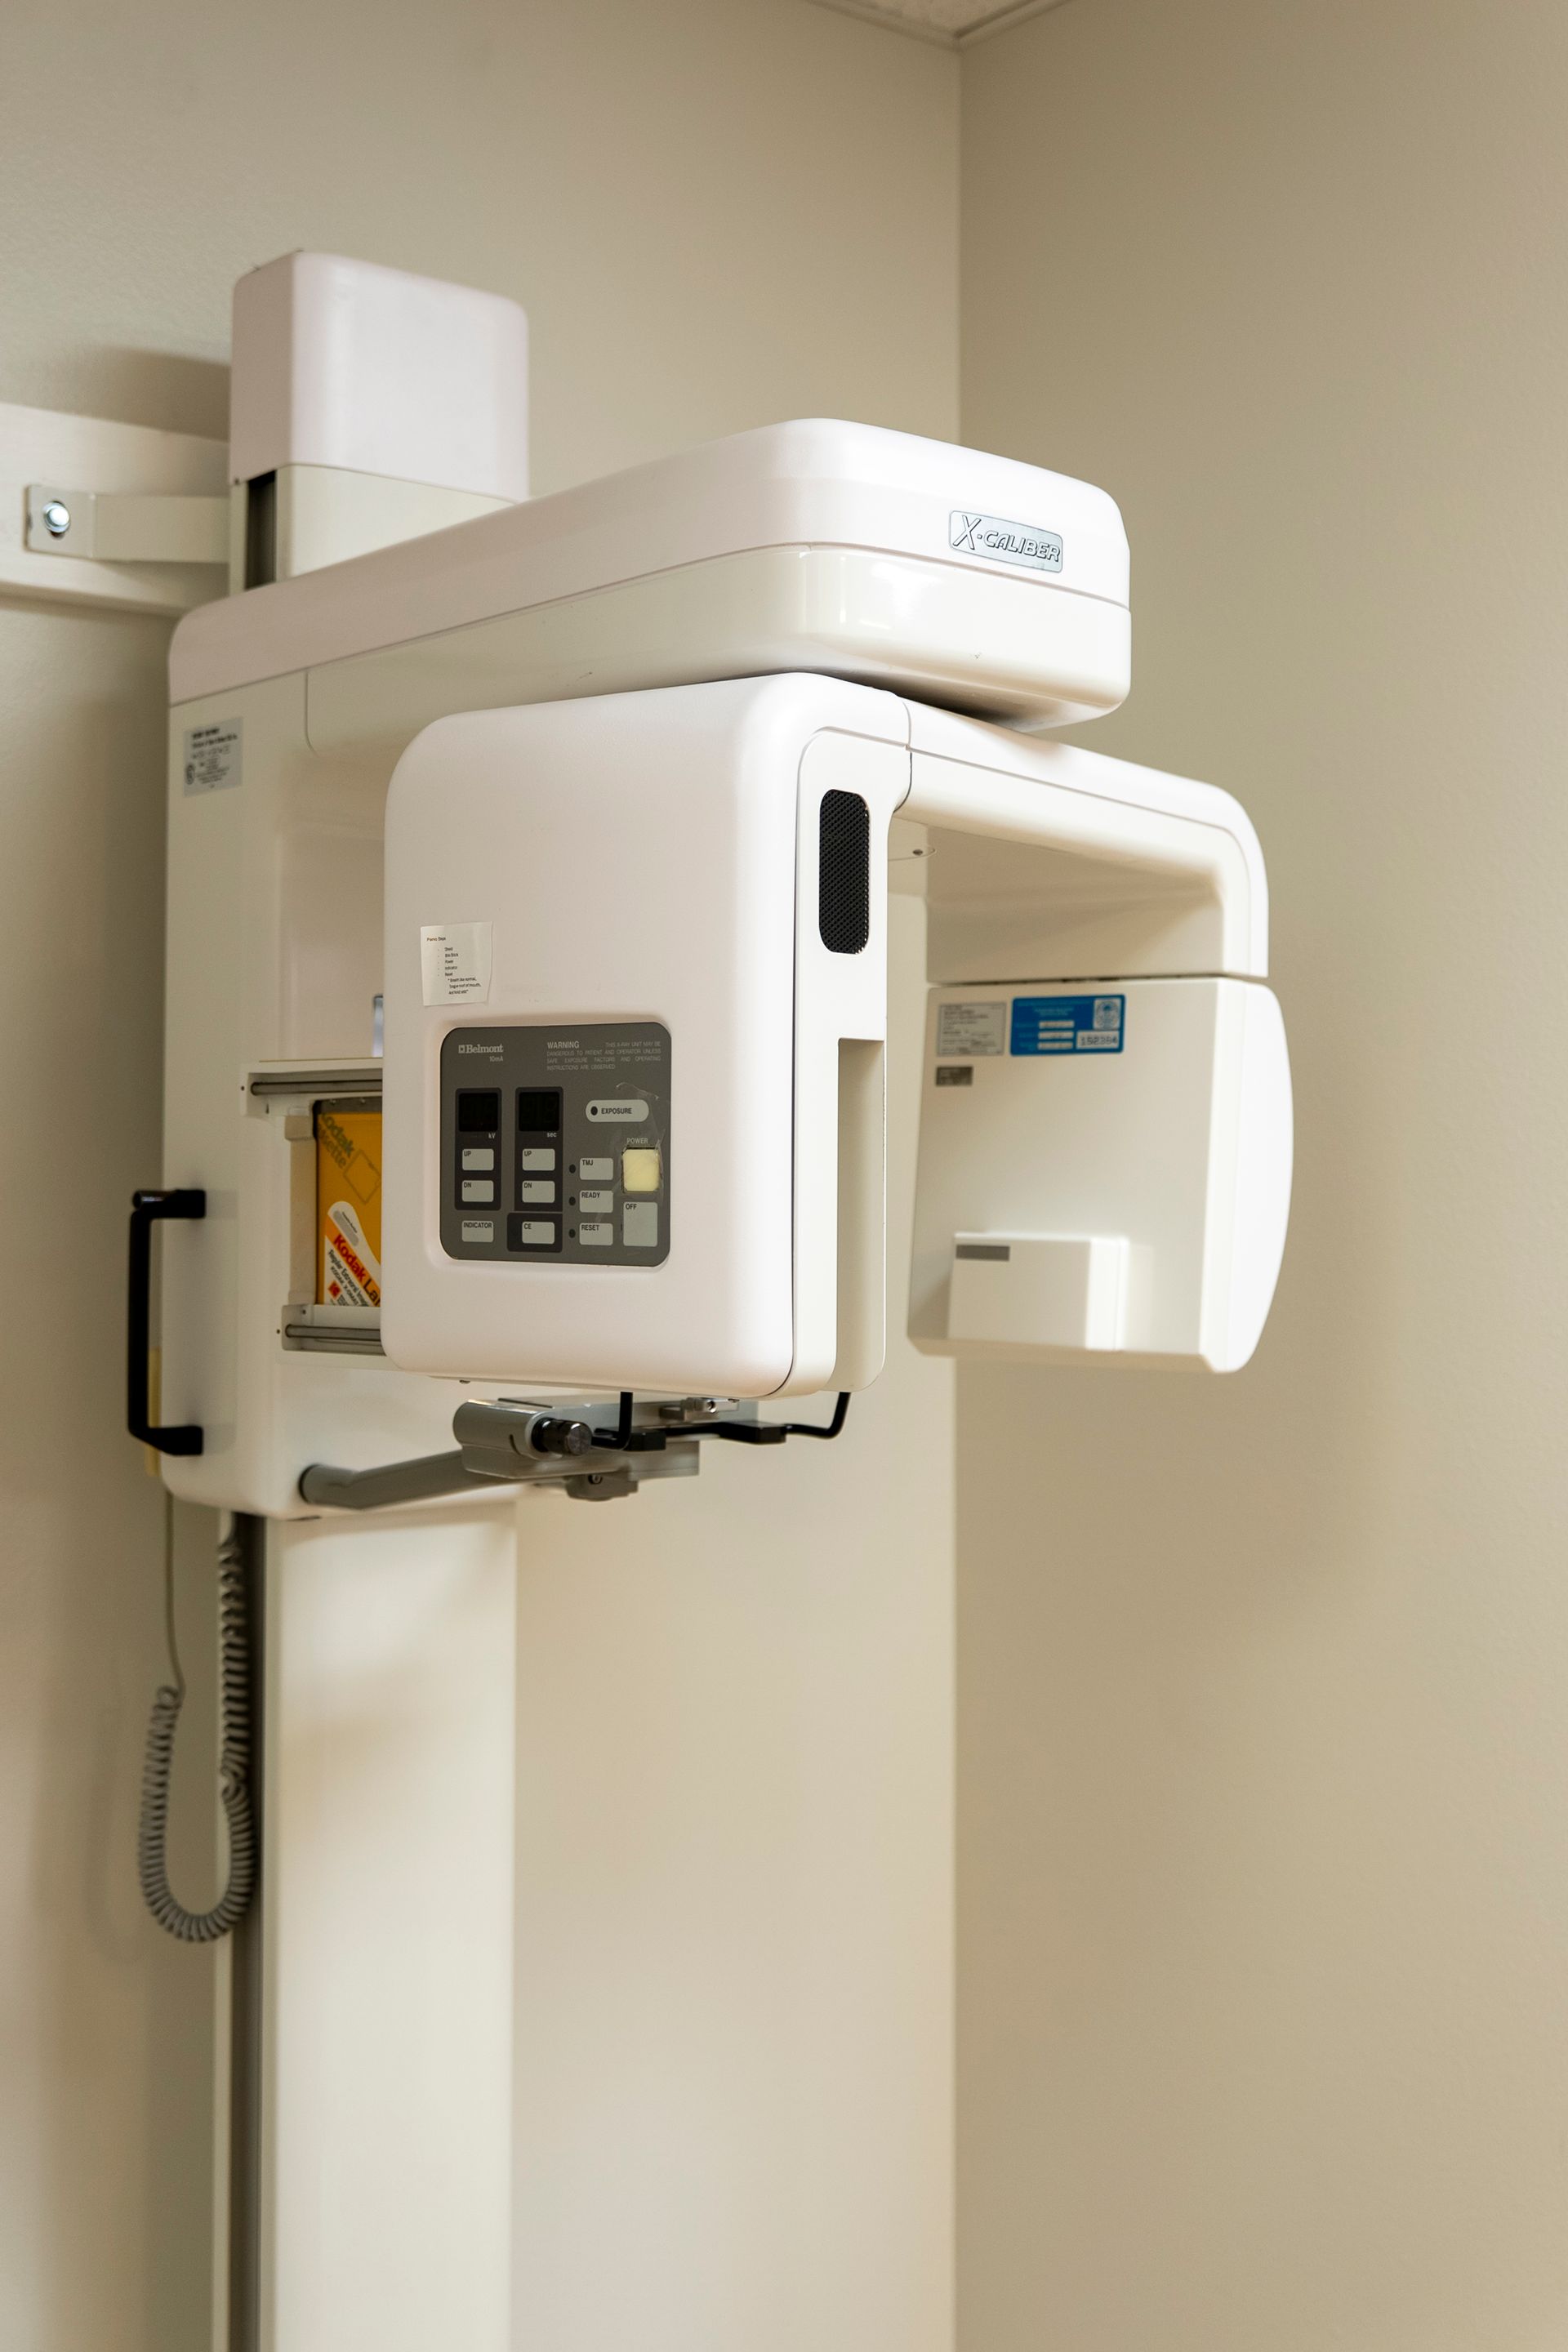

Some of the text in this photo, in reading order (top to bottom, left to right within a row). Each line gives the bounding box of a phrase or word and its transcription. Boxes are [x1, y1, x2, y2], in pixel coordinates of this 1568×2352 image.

[466, 1044, 504, 1054] Belmont
[547, 1040, 580, 1049] WARNING
[334, 1234, 366, 1283] Kodak
